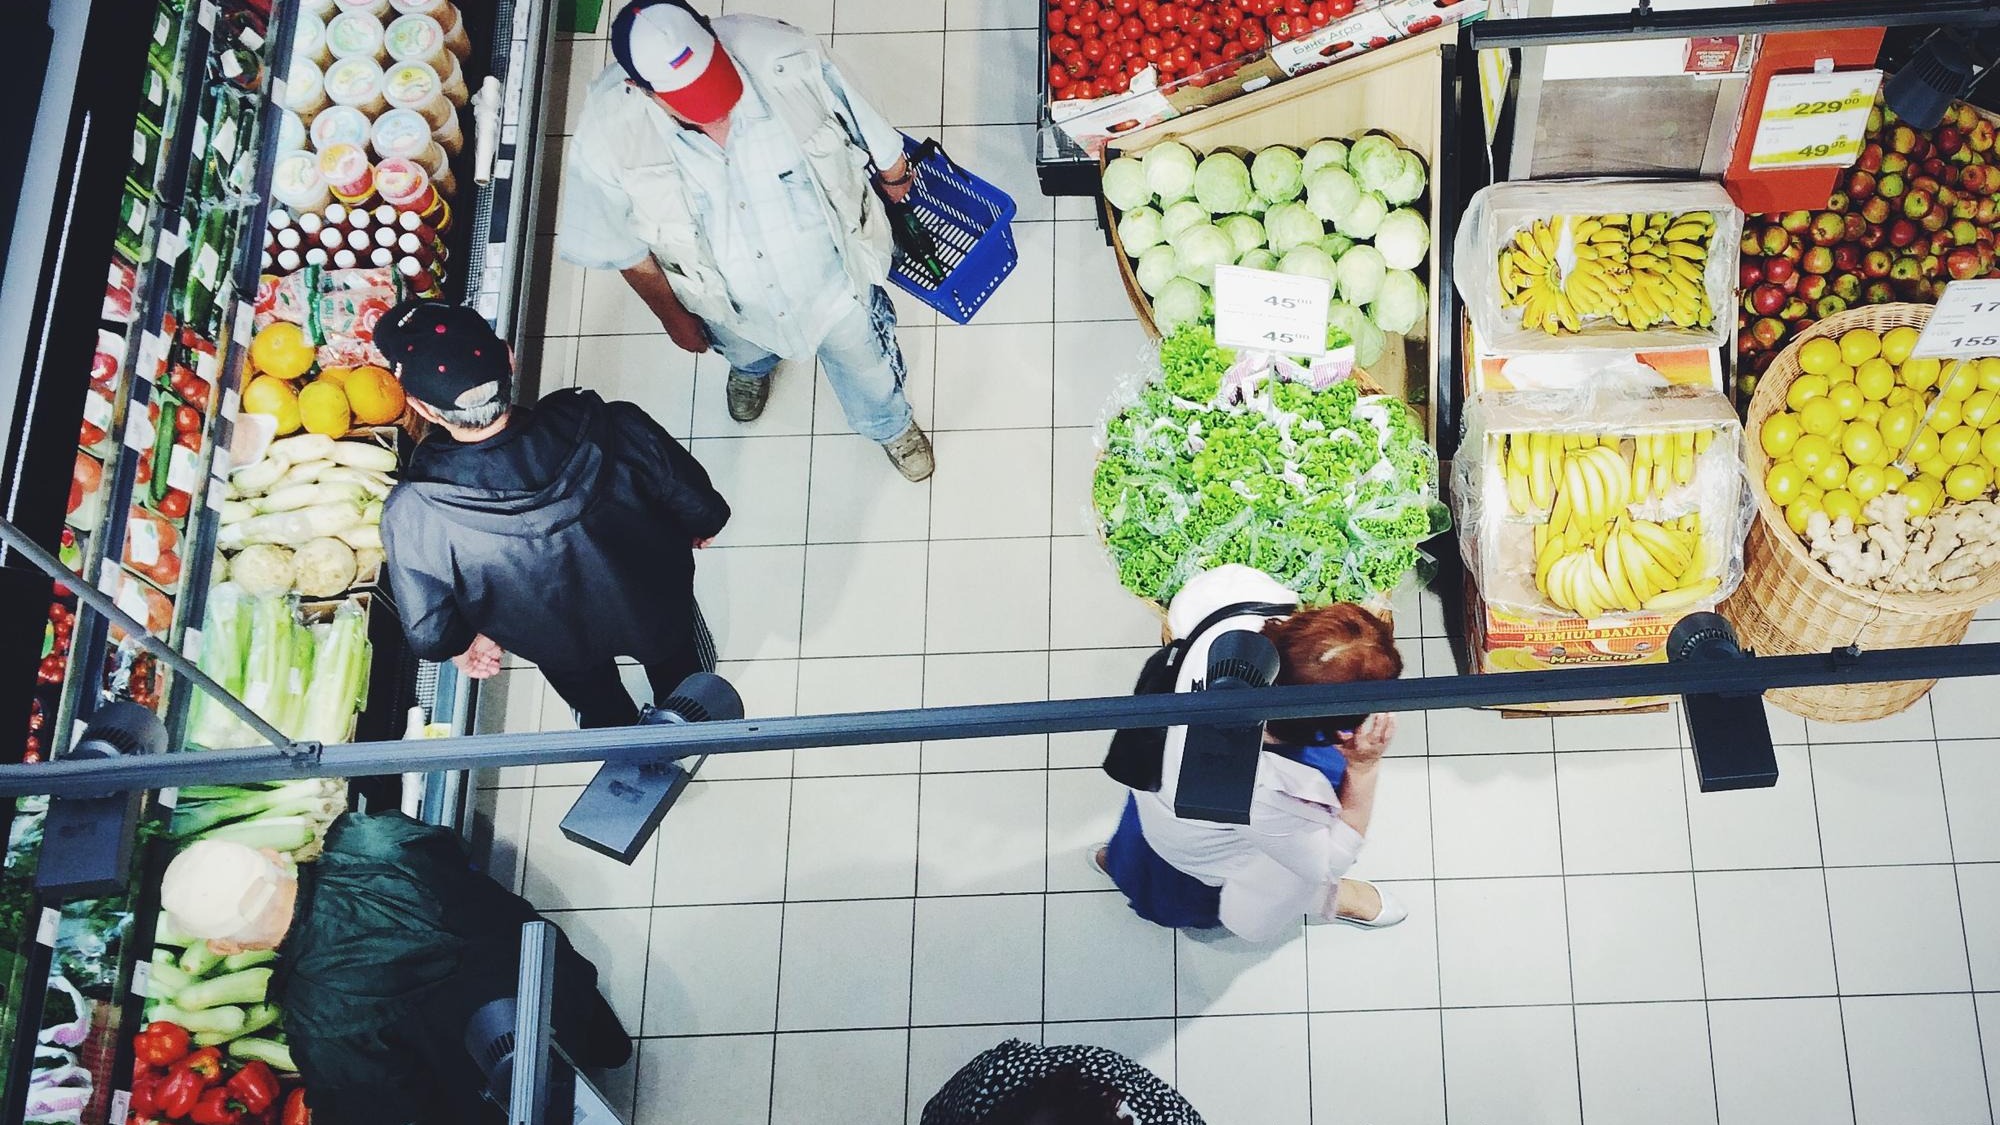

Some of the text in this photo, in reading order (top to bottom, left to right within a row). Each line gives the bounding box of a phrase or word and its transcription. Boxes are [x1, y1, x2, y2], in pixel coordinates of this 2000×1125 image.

[1794, 101, 1843, 115] 229
[1798, 144, 1829, 157] 49
[1264, 296, 1296, 309] 45
[1262, 331, 1294, 343] 45
[1951, 335, 1999, 347] 155
[1523, 625, 1672, 642] PREMIUM BANANA
